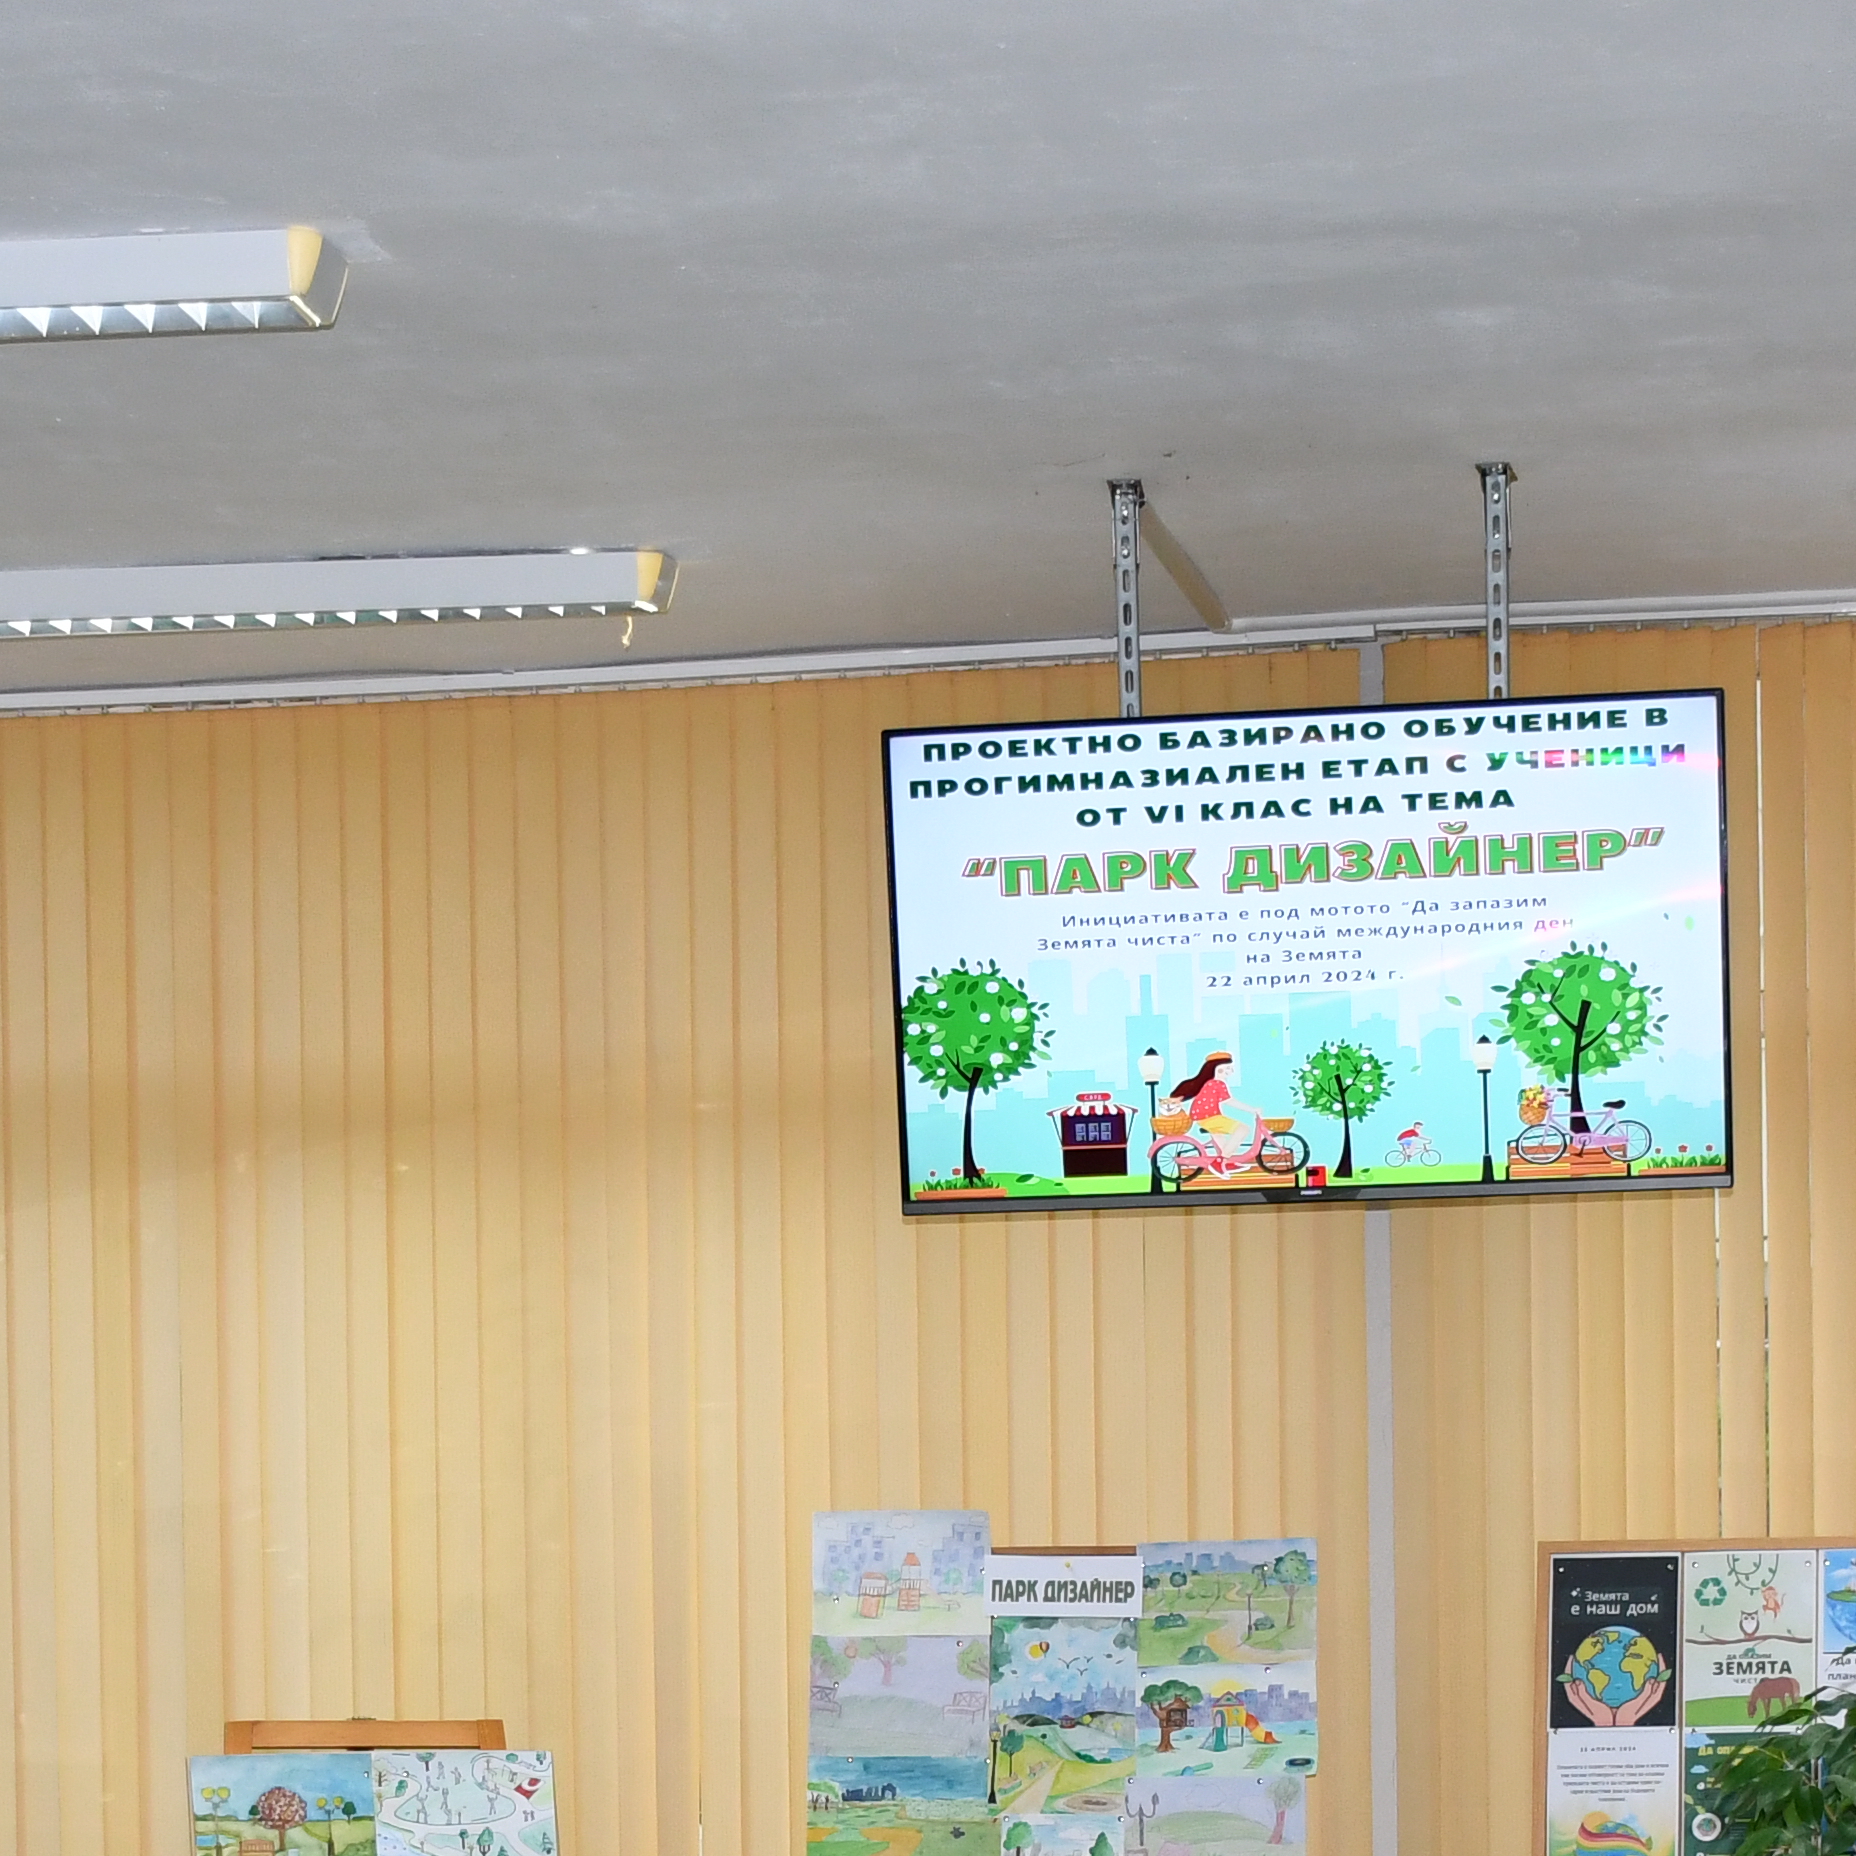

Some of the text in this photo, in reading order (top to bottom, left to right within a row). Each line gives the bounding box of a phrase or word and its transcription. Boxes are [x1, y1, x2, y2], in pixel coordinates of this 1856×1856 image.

[923, 707, 1669, 762] ПРОЕКТНО БАЗИРАНО ОБУЧЕНИЕ В
[910, 744, 1685, 799] ПРОГИМНАЗИАЛЕН ЕТАП С УЧЕНИЦИ
[1076, 789, 1515, 827] ОТ VI КЛАС НА ТЕМА
[1062, 909, 1228, 928] Инициативата
[1239, 909, 1249, 920] е
[1260, 907, 1300, 921] под
[1310, 903, 1390, 917] мотото
[1450, 896, 1548, 911] запазим
[1037, 937, 1117, 951] Земята
[1212, 932, 1237, 944] по
[1248, 926, 1326, 945] случай
[1337, 919, 1524, 939] международния
[1534, 917, 1574, 933] ден
[1246, 948, 1362, 964] на Земята
[1206, 969, 1404, 988] 22 април 2024 г.
[991, 1578, 1135, 1603] ПАРК ДИЗАЙНЕР
[1584, 1591, 1629, 1602] Земята
[1571, 1602, 1659, 1617] е наш дом
[1712, 1660, 1792, 1675] ЗЕМЯТА
